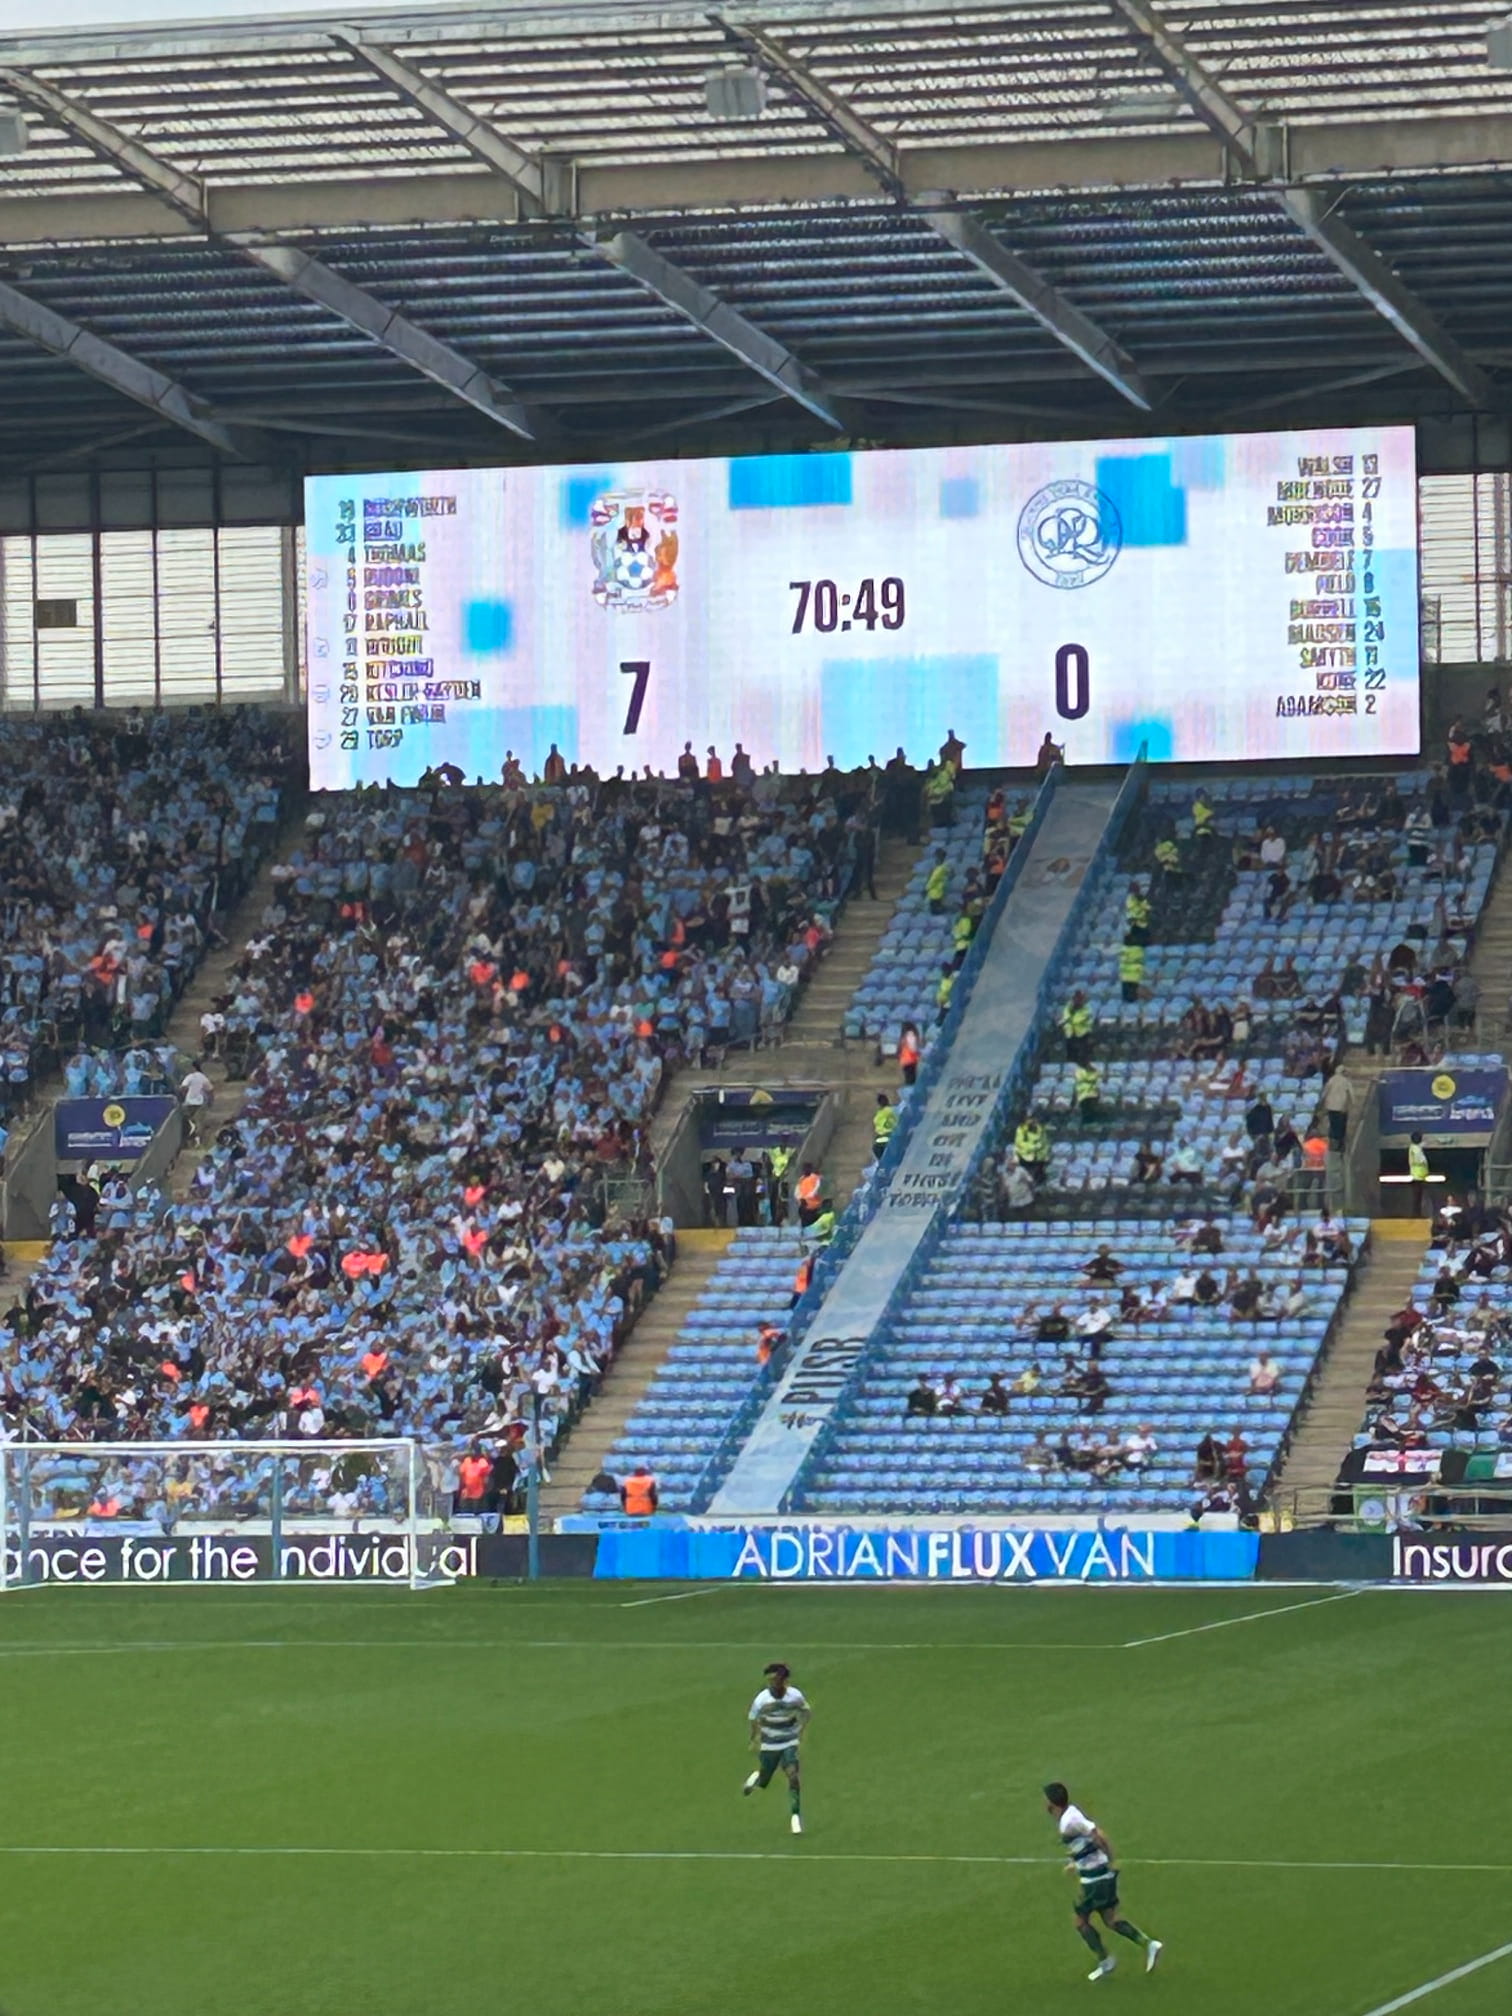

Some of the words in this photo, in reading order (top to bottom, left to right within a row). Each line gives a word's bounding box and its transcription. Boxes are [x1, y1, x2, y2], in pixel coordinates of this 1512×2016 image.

[1362, 477, 1382, 498] 27
[1363, 549, 1373, 570] 7
[789, 577, 906, 634] 70:49
[1055, 643, 1089, 720] 0
[1364, 668, 1386, 690] 22
[620, 661, 650, 735] 7
[1365, 694, 1377, 714] 2
[120, 1537, 175, 1579] for
[189, 1536, 259, 1579] the
[280, 1535, 477, 1579] ndividual
